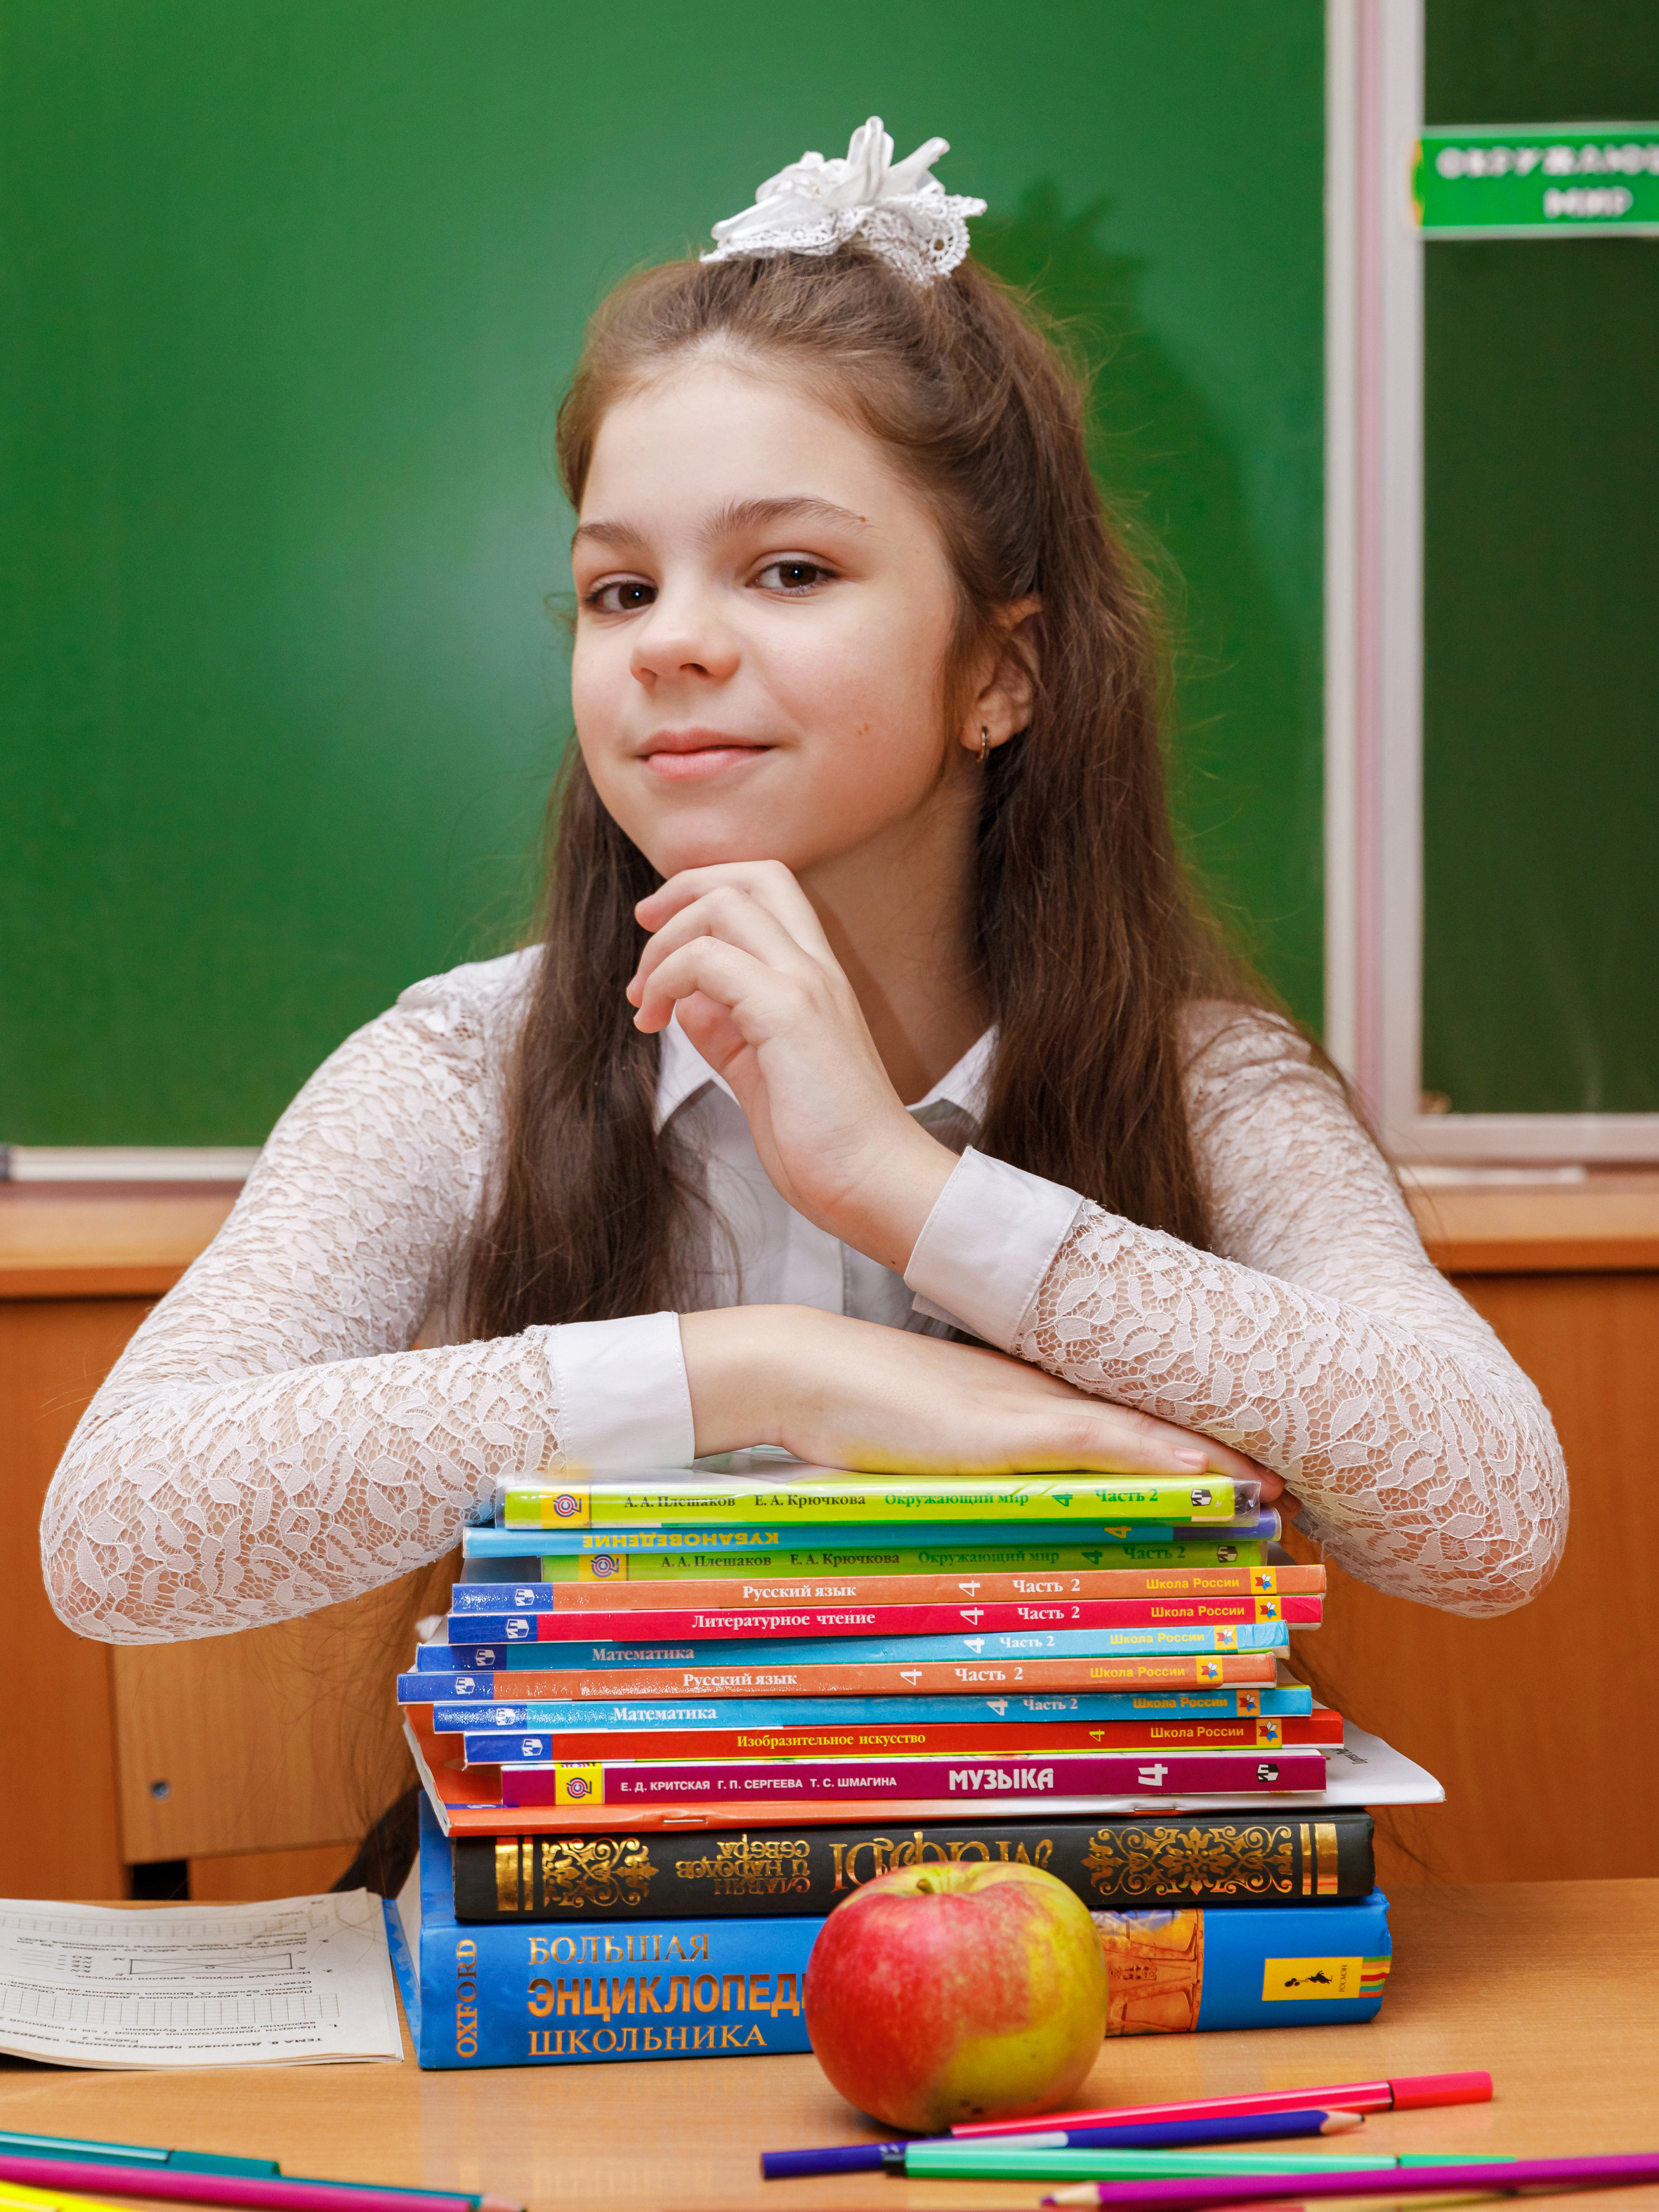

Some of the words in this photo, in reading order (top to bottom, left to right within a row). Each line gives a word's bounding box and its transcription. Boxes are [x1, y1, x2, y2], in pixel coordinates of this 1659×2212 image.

[657, 1496, 735, 1507] Плешаков
[787, 1495, 866, 1508] Крючкова
[885, 1493, 993, 1507] Окружающий
[997, 1493, 1029, 1506] мир
[1051, 1493, 1073, 1507] 4
[1095, 1488, 1146, 1503] Часть
[1149, 1488, 1158, 1502] 2
[582, 1531, 780, 1548] КУБАНОВЕДЕНИЕ
[1104, 1526, 1132, 1539] 4
[694, 1555, 772, 1567] Плешаков
[822, 1552, 900, 1567] Крючкова
[918, 1551, 1025, 1566] Окружающий
[1030, 1551, 1060, 1564] мир
[1081, 1550, 1103, 1565] 4
[1124, 1546, 1173, 1560] Часть
[1176, 1545, 1186, 1559] 2
[743, 1585, 811, 1602] Русский
[815, 1585, 857, 1598] язык
[959, 1581, 981, 1597] 4
[1013, 1579, 1063, 1593] Часть
[1071, 1578, 1080, 1592] 2
[1146, 1578, 1189, 1590] Школа
[1193, 1577, 1240, 1588] России
[692, 1614, 811, 1630] Литературное
[816, 1613, 876, 1625] чтение
[960, 1607, 984, 1625] 4
[1017, 1607, 1065, 1620] Часть
[1071, 1606, 1080, 1619] 2
[1151, 1606, 1194, 1618] Школа
[1198, 1605, 1245, 1616] России
[591, 1647, 695, 1661] Математика
[964, 1637, 985, 1654] 4
[999, 1637, 1043, 1649] Часть
[1046, 1635, 1055, 1647] 2
[1110, 1634, 1153, 1644] Школа
[1158, 1632, 1205, 1643] России
[683, 1673, 752, 1689] Русский
[756, 1673, 797, 1685] язык
[900, 1668, 922, 1686] 4
[955, 1668, 1006, 1682] Часть
[1014, 1667, 1023, 1681] 2
[1090, 1667, 1134, 1678] Школа
[1138, 1665, 1186, 1677] России
[613, 1707, 717, 1722] Математика
[986, 1699, 1009, 1716] 4
[1023, 1698, 1067, 1711] Часть
[1069, 1697, 1078, 1710] 2
[1133, 1698, 1176, 1709] Школа
[1180, 1696, 1228, 1708] России
[737, 1733, 854, 1749] Изобразительное
[858, 1733, 926, 1746] искусство
[1089, 1729, 1106, 1742] 4
[1150, 1727, 1194, 1739] Школа
[1197, 1726, 1244, 1737] России
[621, 1781, 633, 1792] Е.
[634, 1781, 648, 1793] Д.
[650, 1780, 710, 1791] КРИТСКАЯ
[717, 1780, 727, 1791] Г.
[729, 1780, 742, 1791] П.
[745, 1779, 803, 1790] СЕРГЕЕВА
[810, 1778, 820, 1788] Т.
[822, 1777, 834, 1788] С.
[837, 1776, 897, 1788] ШМАГИНА
[949, 1768, 1054, 1791] МУЗЫКА
[1138, 1763, 1168, 1786] 4
[714, 1877, 811, 1895] СЛАВЯН
[528, 1934, 711, 1964] БОЛЬШАЯ
[456, 1939, 478, 2059] OXFORD
[527, 1974, 806, 2021] ЭНЦИКЛОПЕД
[528, 2024, 767, 2056] ШКОЛЬНИКА
